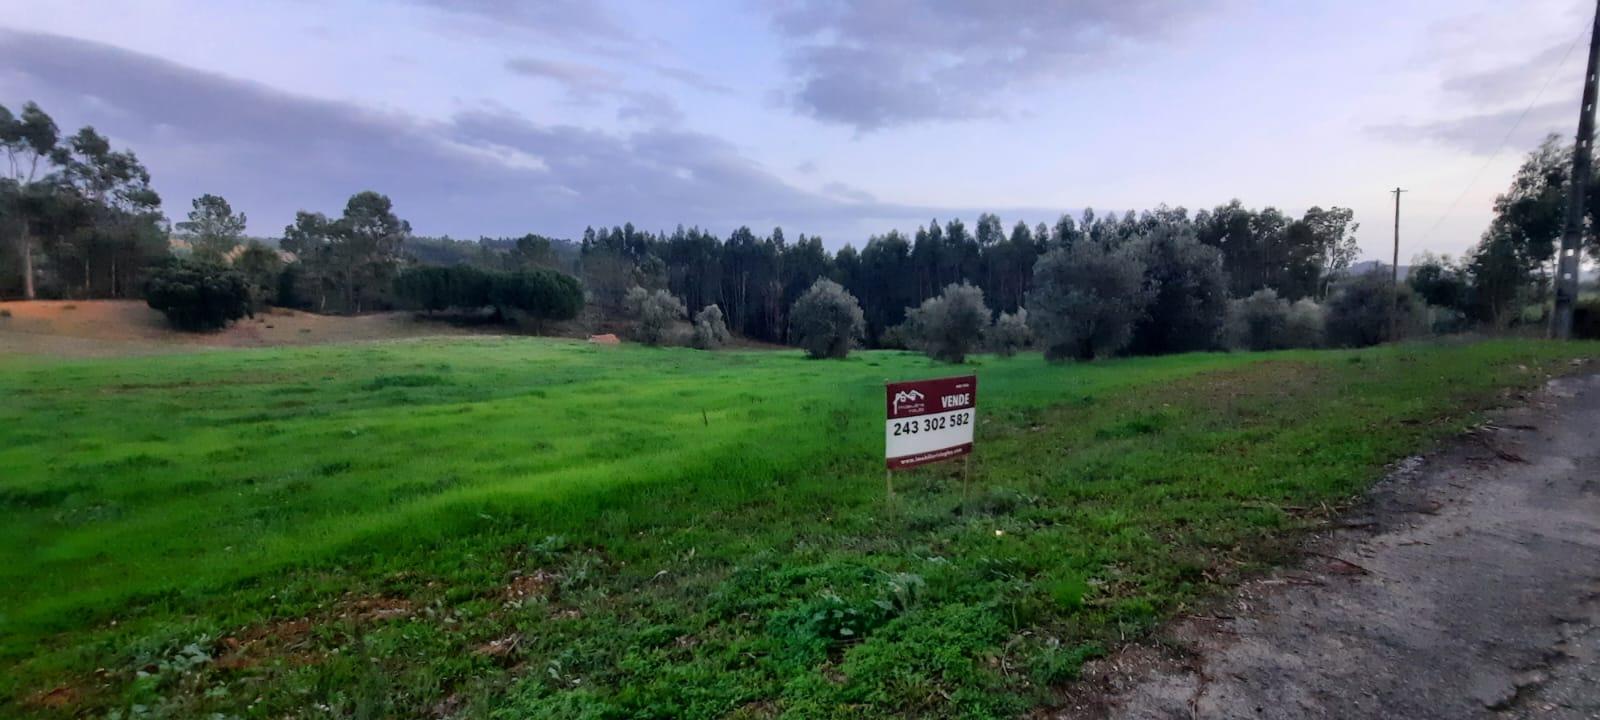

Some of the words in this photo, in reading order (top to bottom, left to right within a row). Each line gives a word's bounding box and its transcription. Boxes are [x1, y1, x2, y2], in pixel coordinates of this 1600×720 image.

[941, 393, 970, 408] VENDE
[893, 420, 919, 436] 243
[924, 417, 946, 432] 302
[950, 412, 969, 427] 582
